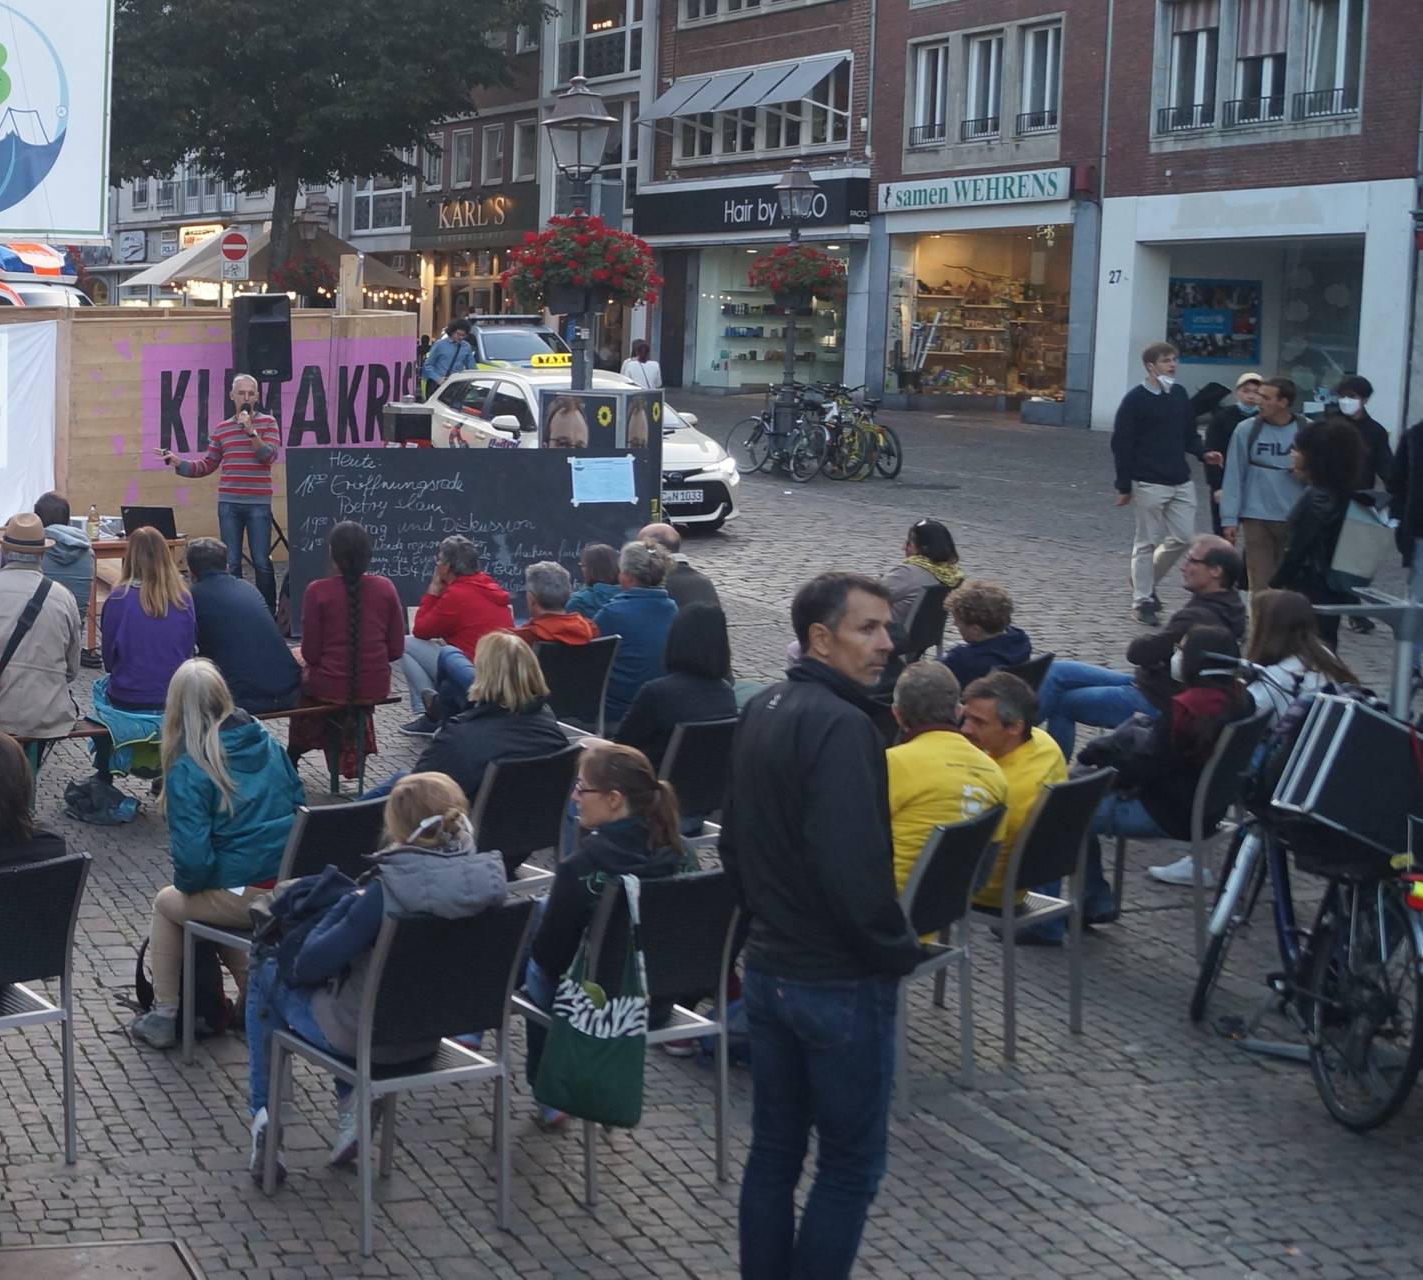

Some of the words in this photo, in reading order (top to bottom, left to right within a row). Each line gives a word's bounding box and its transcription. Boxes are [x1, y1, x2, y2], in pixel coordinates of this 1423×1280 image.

[896, 185, 948, 208] samen
[953, 172, 1058, 203] WEHRENS
[438, 197, 505, 229] KARL'S
[724, 199, 753, 223] Hair
[758, 198, 777, 226] by
[1109, 270, 1122, 284] 27
[329, 451, 382, 469] Heute:
[398, 516, 435, 534] und
[441, 512, 536, 533] Diskussion
